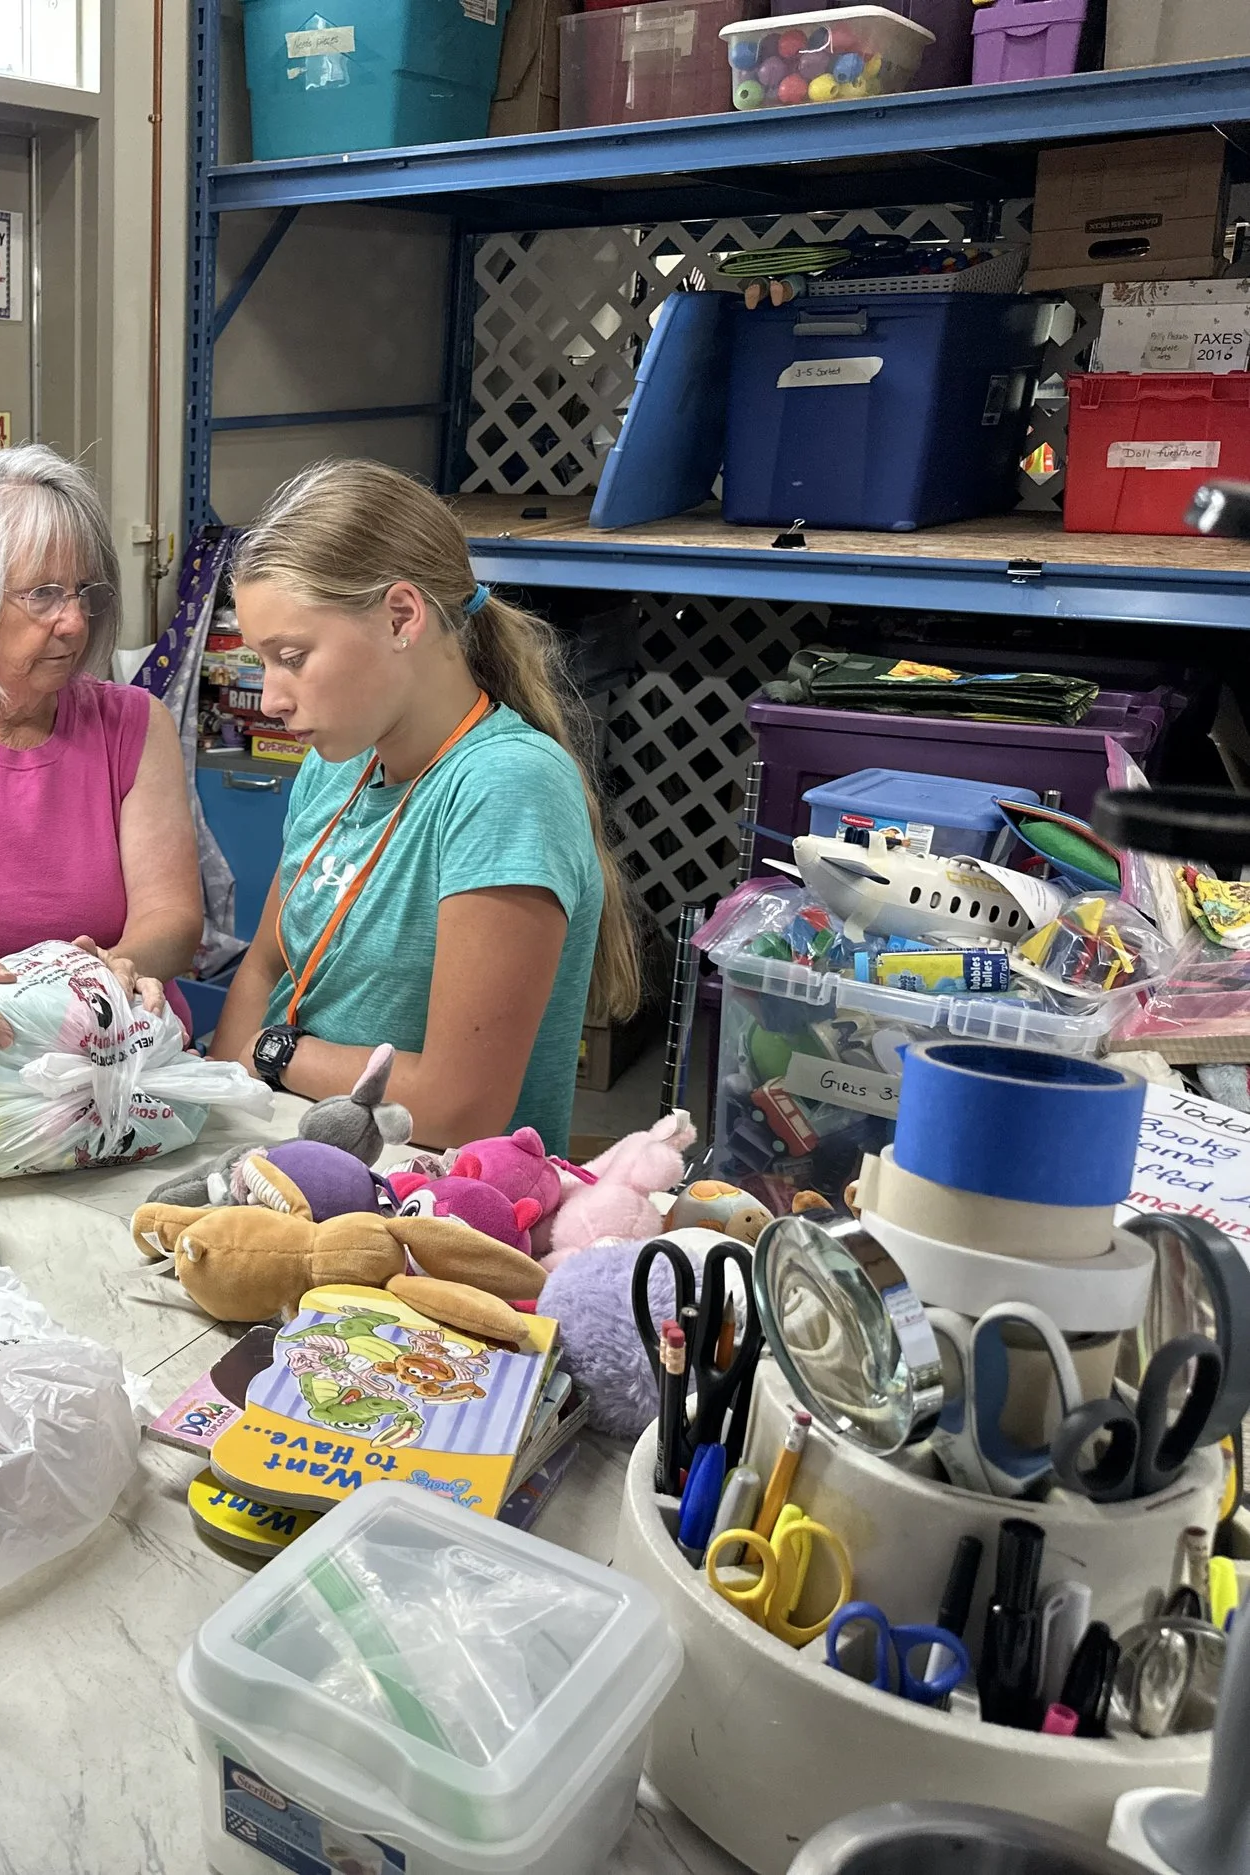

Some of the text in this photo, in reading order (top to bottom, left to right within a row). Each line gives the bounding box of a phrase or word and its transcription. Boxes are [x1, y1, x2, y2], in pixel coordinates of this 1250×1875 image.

[1193, 333, 1244, 345] TAXES
[1123, 448, 1150, 459] Doll
[970, 956, 980, 990] Bubbles
[982, 960, 992, 988] Bulles
[129, 1021, 150, 1037] ONE
[130, 1037, 154, 1055] HELP
[1138, 1134, 1215, 1168] ame
[1141, 1117, 1241, 1160] Books
[174, 1401, 230, 1437] DORA
[243, 1424, 399, 1473] to Have...
[263, 1453, 363, 1491] Want
[208, 1489, 298, 1535] Want
[237, 1773, 286, 1809] Sterilite
